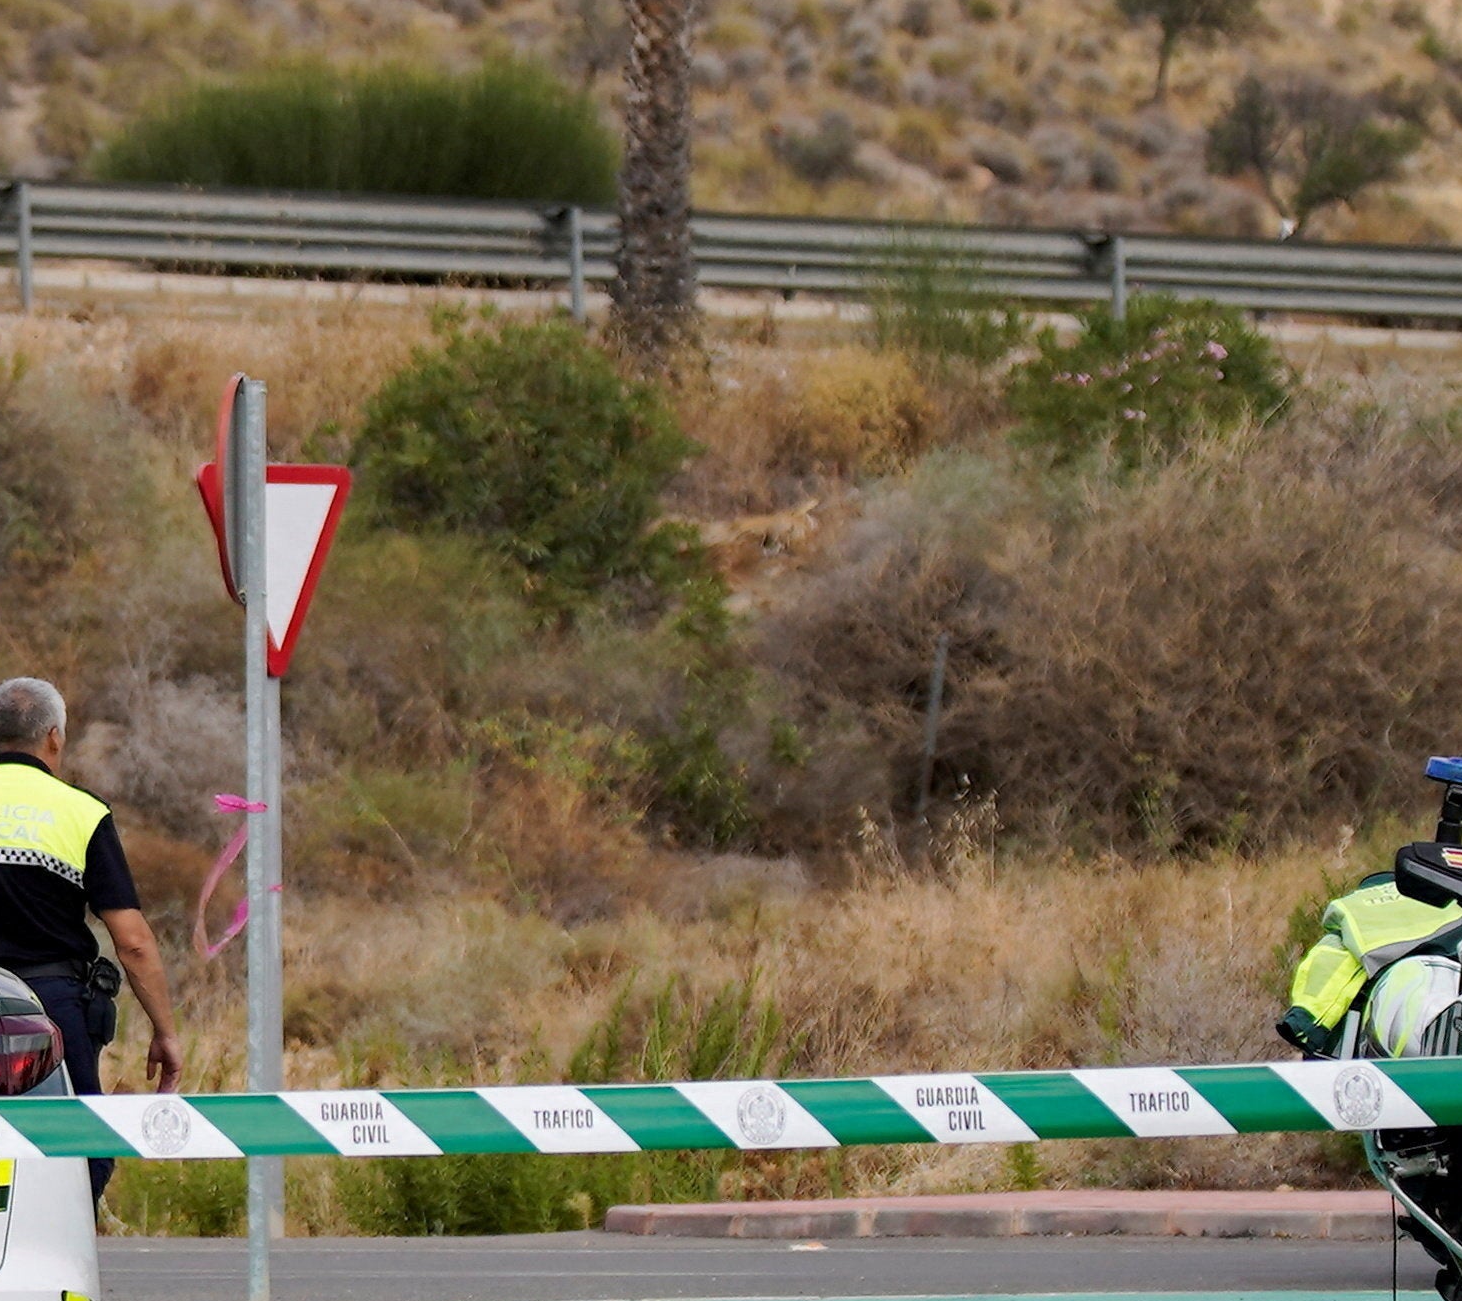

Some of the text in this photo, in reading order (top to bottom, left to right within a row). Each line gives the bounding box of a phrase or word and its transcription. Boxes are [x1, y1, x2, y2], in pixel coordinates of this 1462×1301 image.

[916, 1085, 979, 1107] GUARDIA
[1129, 1090, 1191, 1113] TRAFICO
[320, 1102, 384, 1121] GUARDIA
[533, 1109, 594, 1130] TRAFICO
[948, 1110, 986, 1132] CIVIL
[352, 1124, 390, 1145] CIVIL
